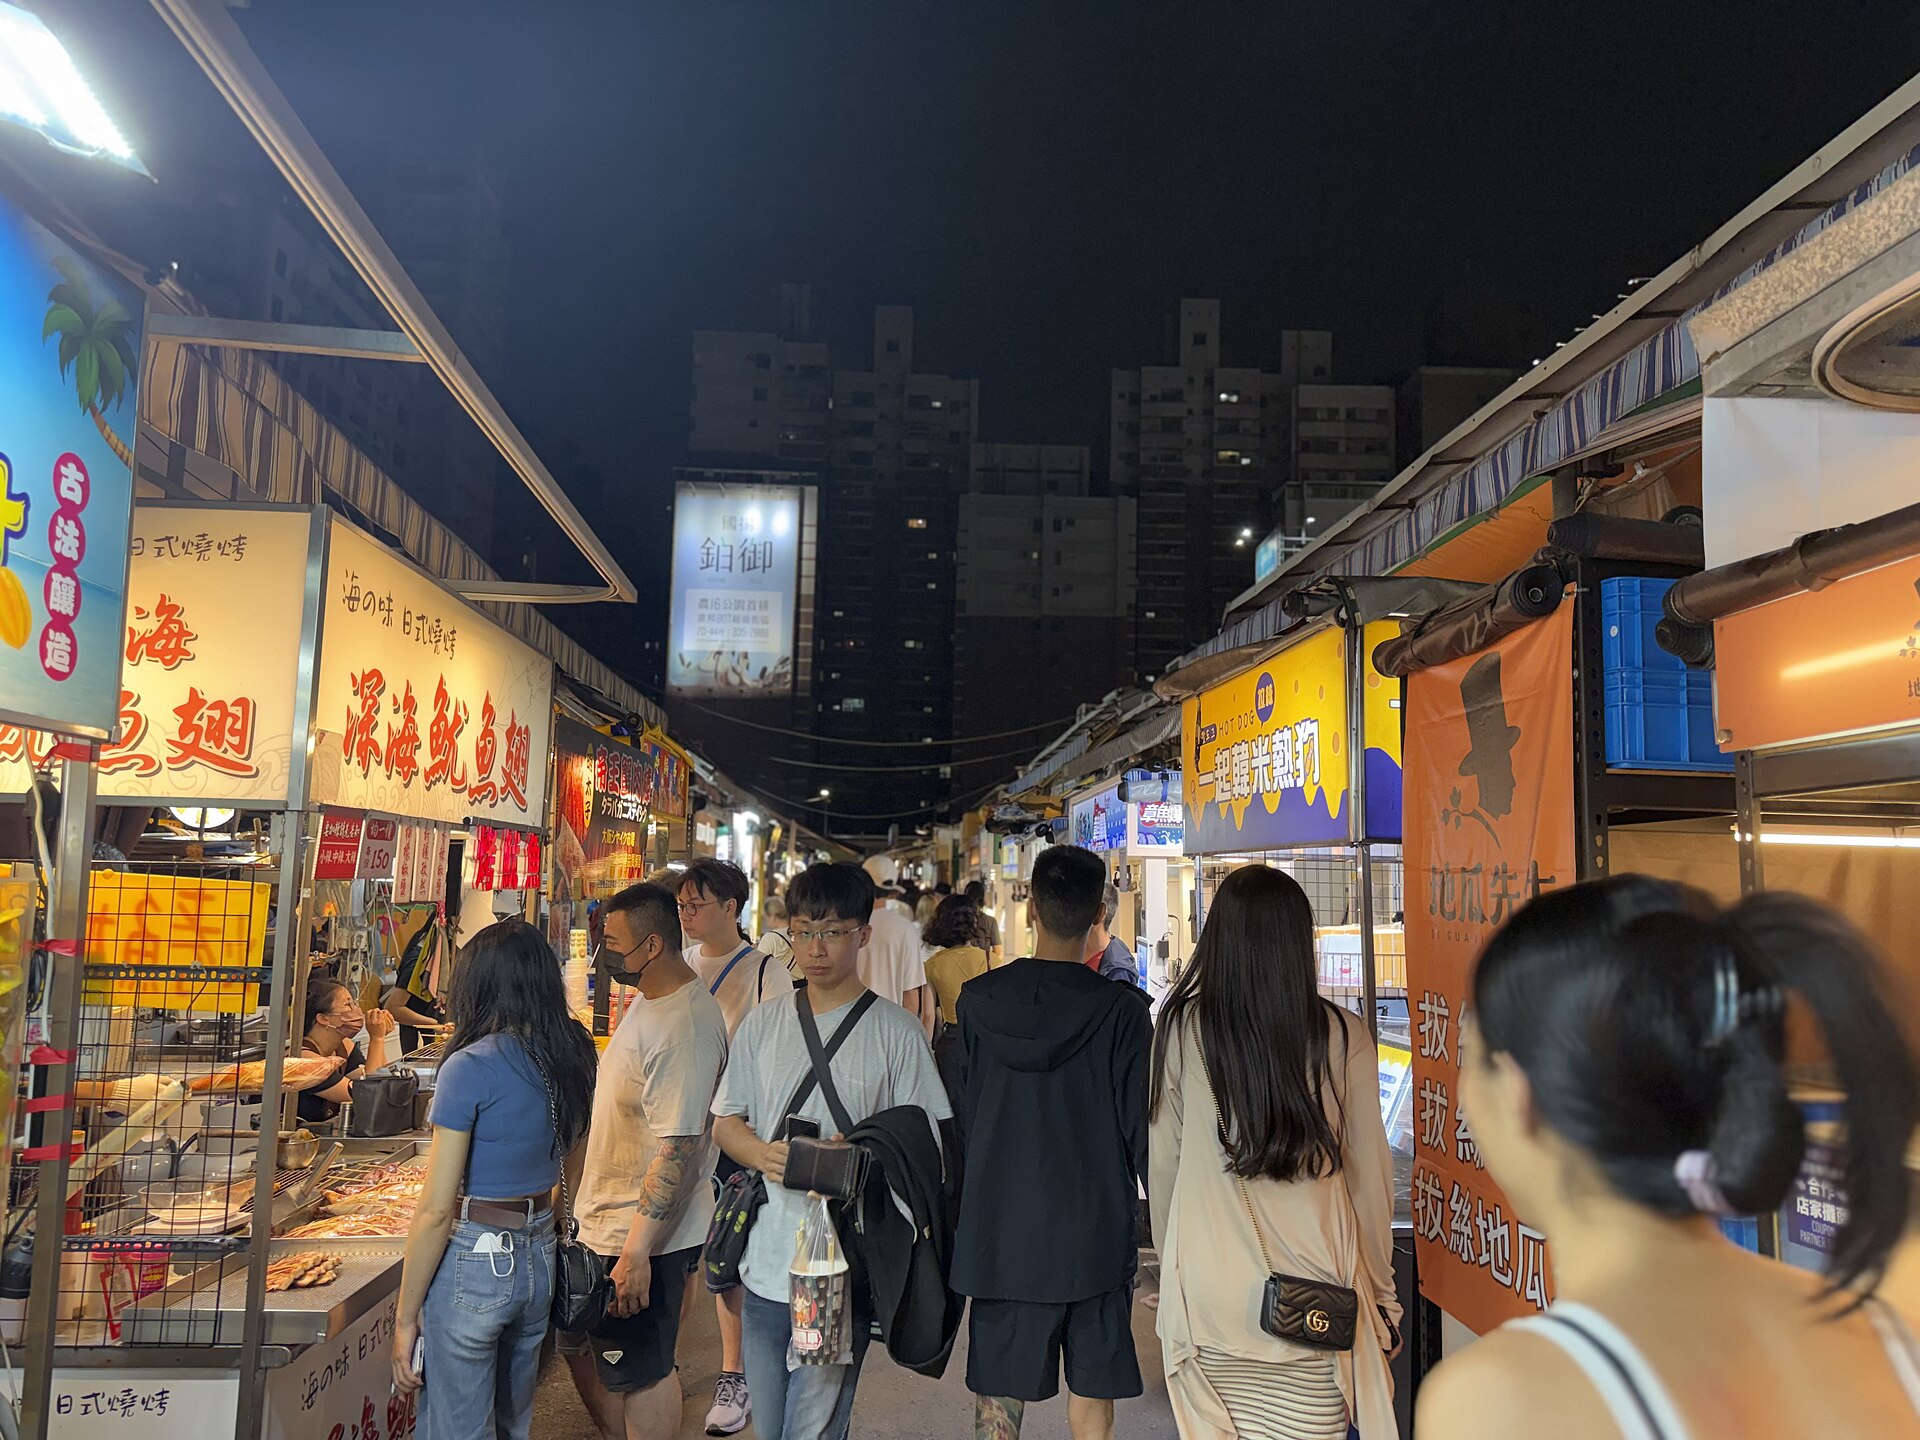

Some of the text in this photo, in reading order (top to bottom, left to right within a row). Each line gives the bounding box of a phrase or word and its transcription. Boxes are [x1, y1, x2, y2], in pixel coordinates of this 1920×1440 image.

[45, 462, 85, 674] 古法釀造
[402, 605, 457, 660] 日式燒烤
[343, 668, 531, 812] 深海魷魚翅
[1219, 717, 1235, 738] HOT
[1237, 709, 1255, 731] DOG
[370, 848, 390, 870] 150
[1413, 1166, 1549, 1313] 拔絲地瓜
[56, 1388, 170, 1418] 日式燒烤
